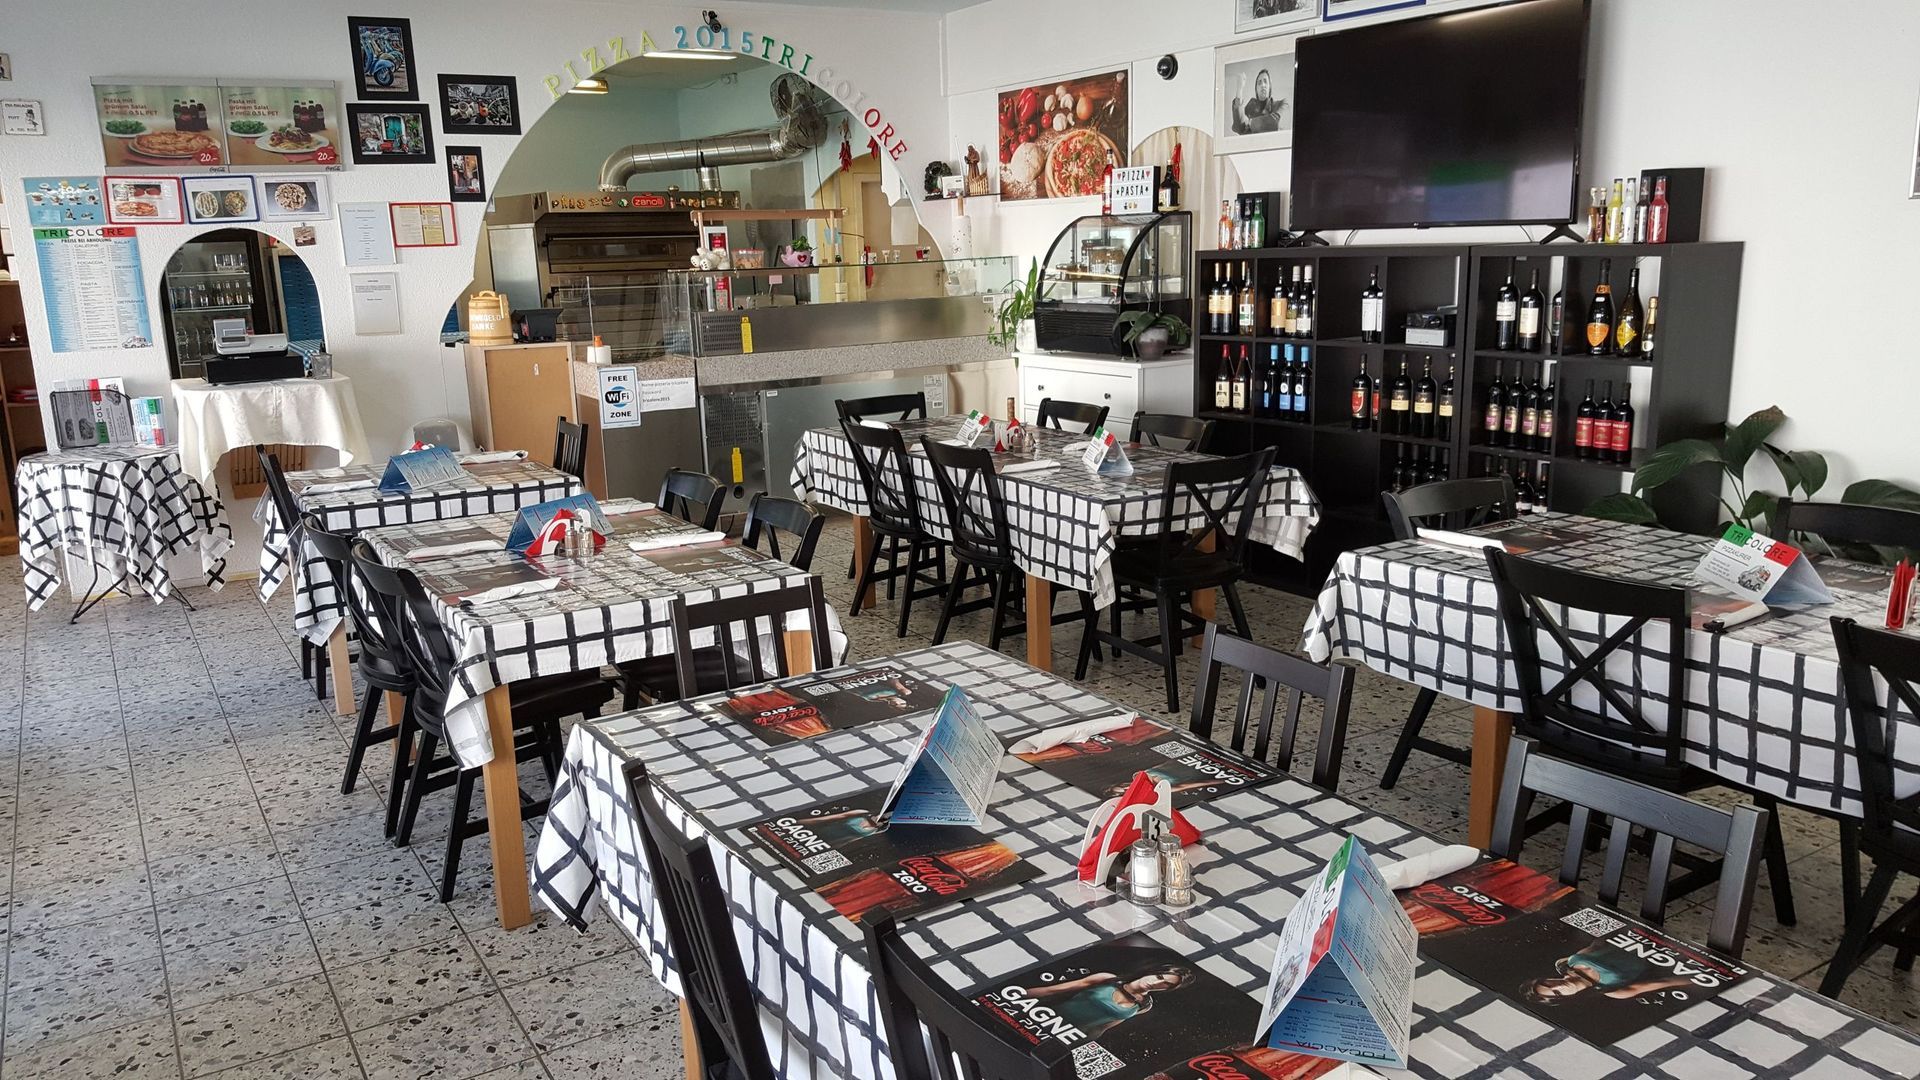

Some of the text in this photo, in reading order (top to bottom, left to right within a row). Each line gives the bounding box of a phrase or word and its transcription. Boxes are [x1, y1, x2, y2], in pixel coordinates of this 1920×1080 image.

[543, 25, 908, 161] PIZZA 2015 TRICOLORE
[1122, 170, 1146, 182] PIZZA
[1120, 185, 1144, 196] PASTA
[40, 228, 125, 237] TRICOLORE
[1730, 530, 1788, 560] TRICOLORE
[842, 673, 902, 690] GAGNE
[760, 706, 796, 717] zero
[1176, 756, 1246, 786] GAGNE
[776, 818, 832, 854] GAGNE
[892, 870, 928, 894] zero
[1452, 885, 1503, 909] zero
[1606, 934, 1721, 988] GAGNE
[986, 992, 1019, 1017] PS4
[1000, 985, 1087, 1046] GAGNE
[1296, 1040, 1386, 1059] FOCACCIA
